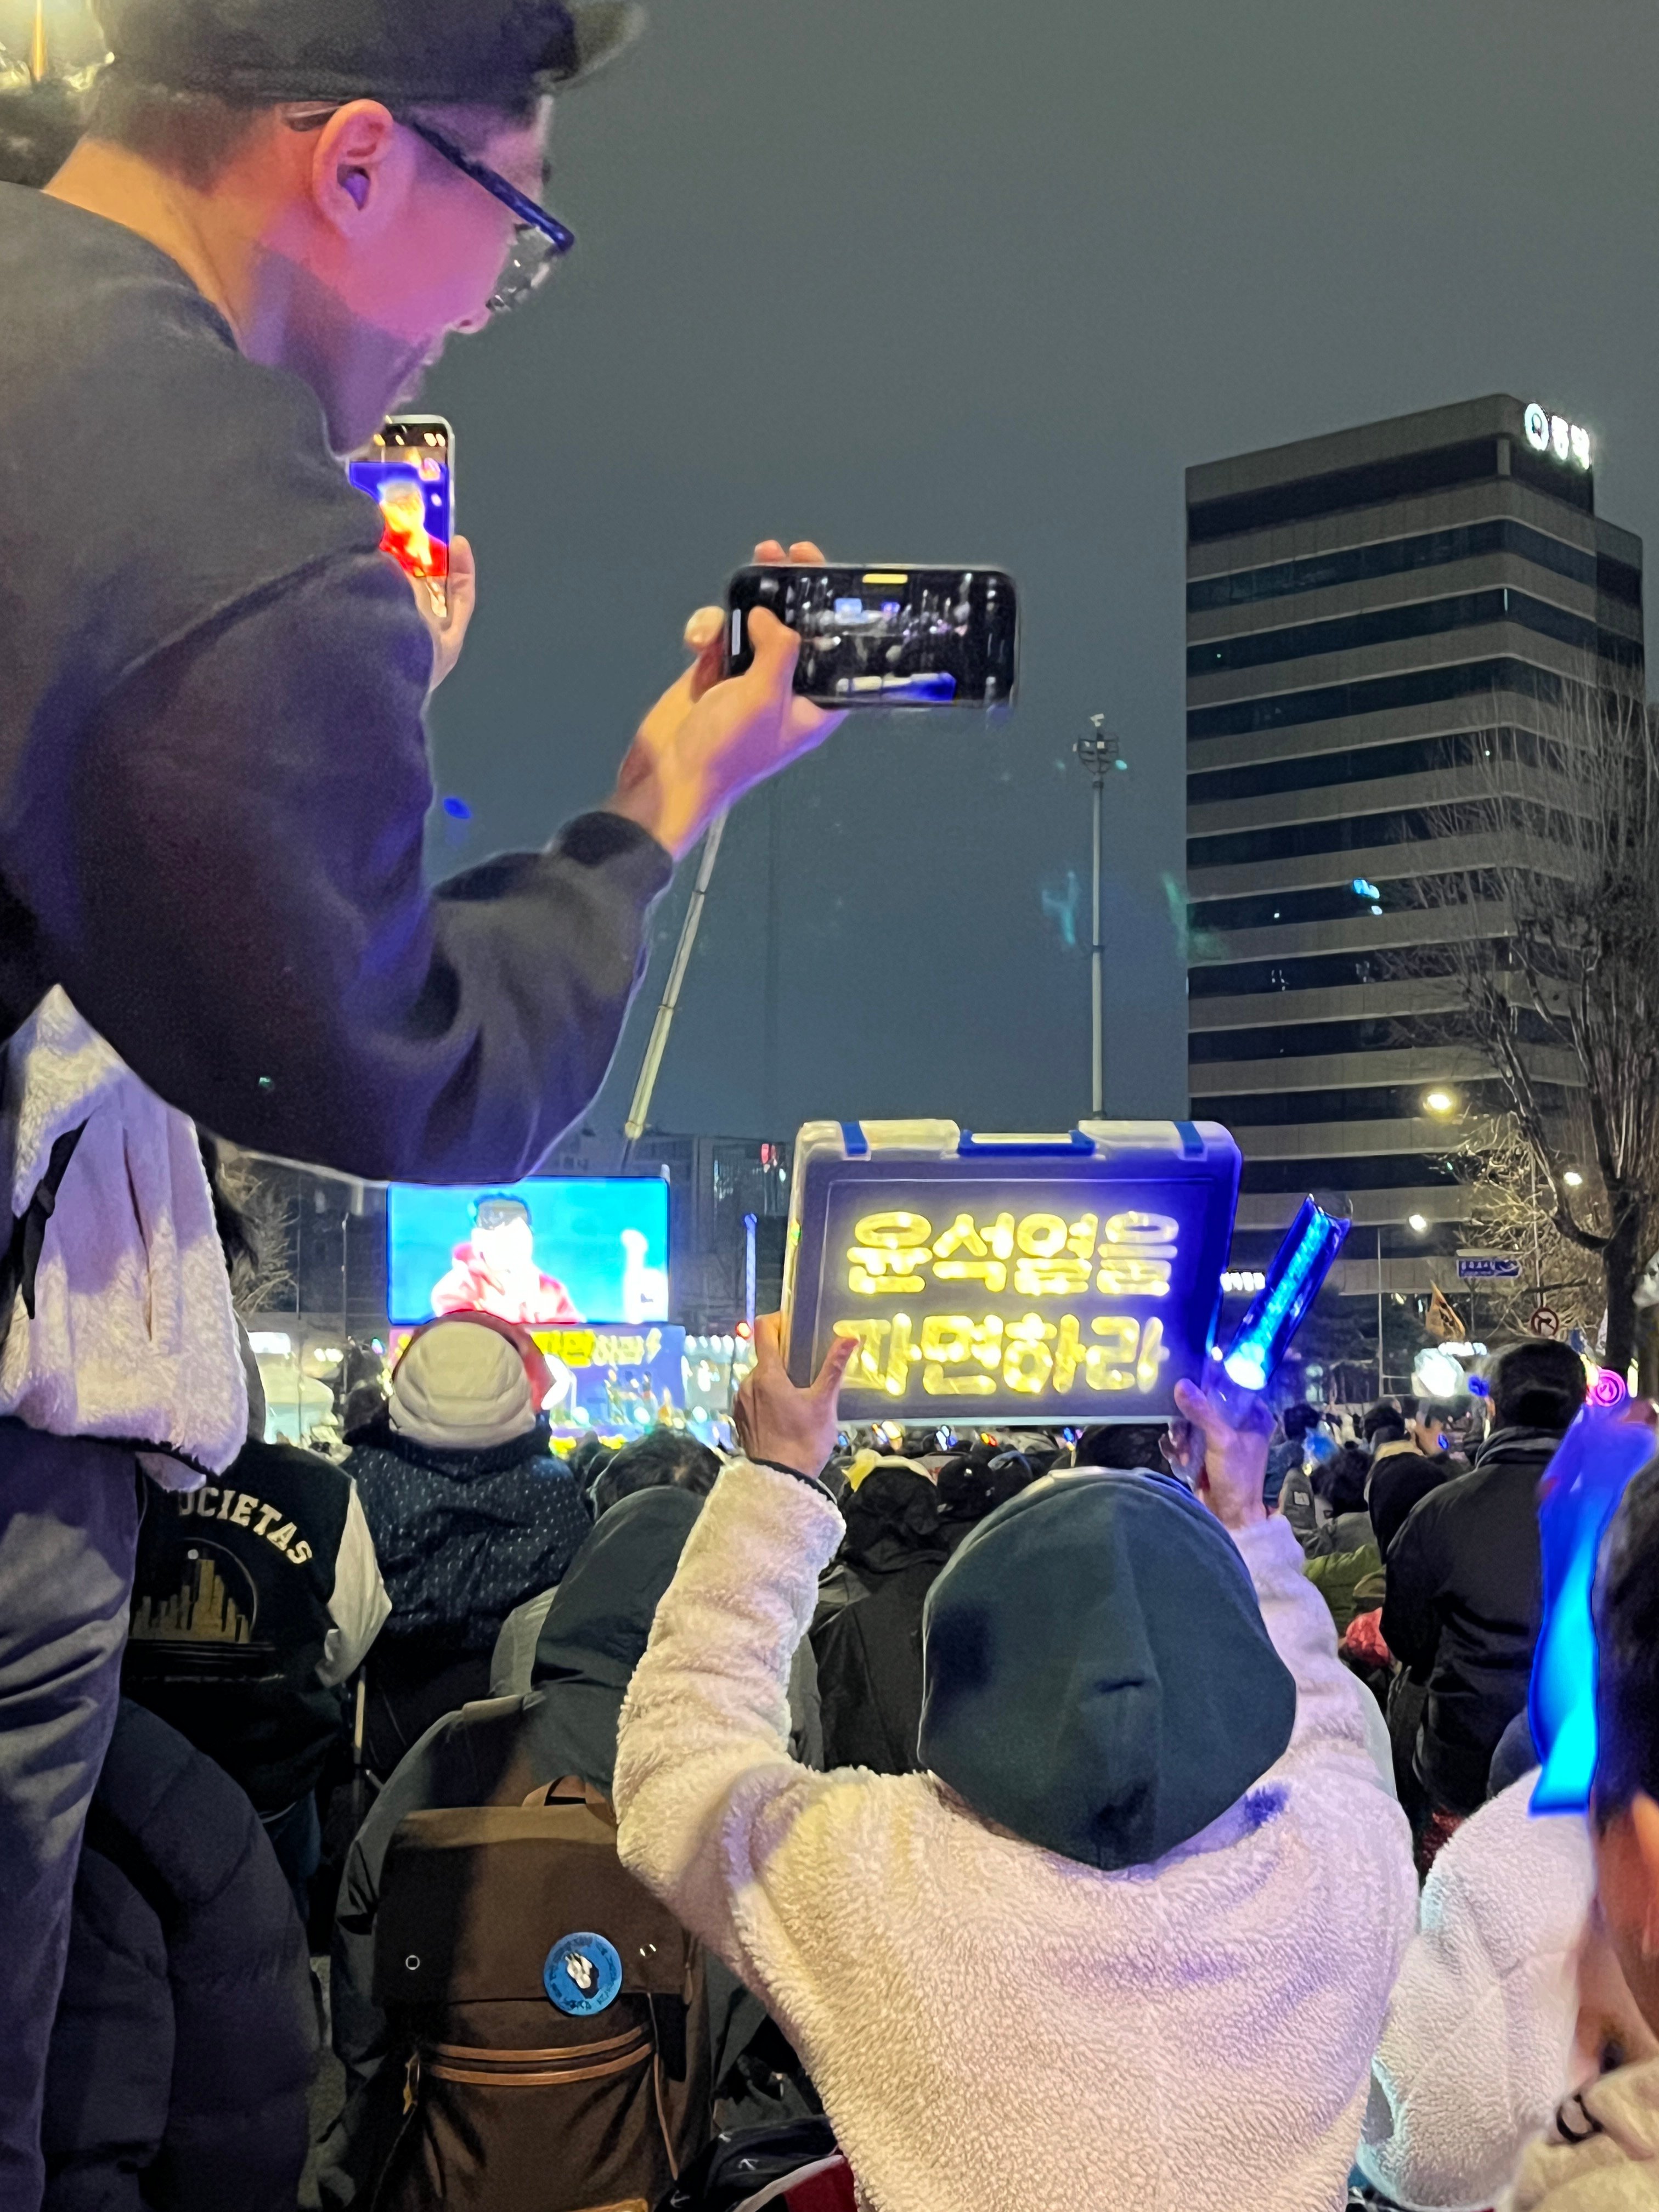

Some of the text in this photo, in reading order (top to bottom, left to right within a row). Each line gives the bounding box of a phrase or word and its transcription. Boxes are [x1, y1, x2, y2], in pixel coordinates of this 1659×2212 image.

[847, 1210, 1180, 1296] 윤석열을
[832, 1312, 1170, 1397] 파면하라
[178, 1486, 313, 1565] OCIETAS
